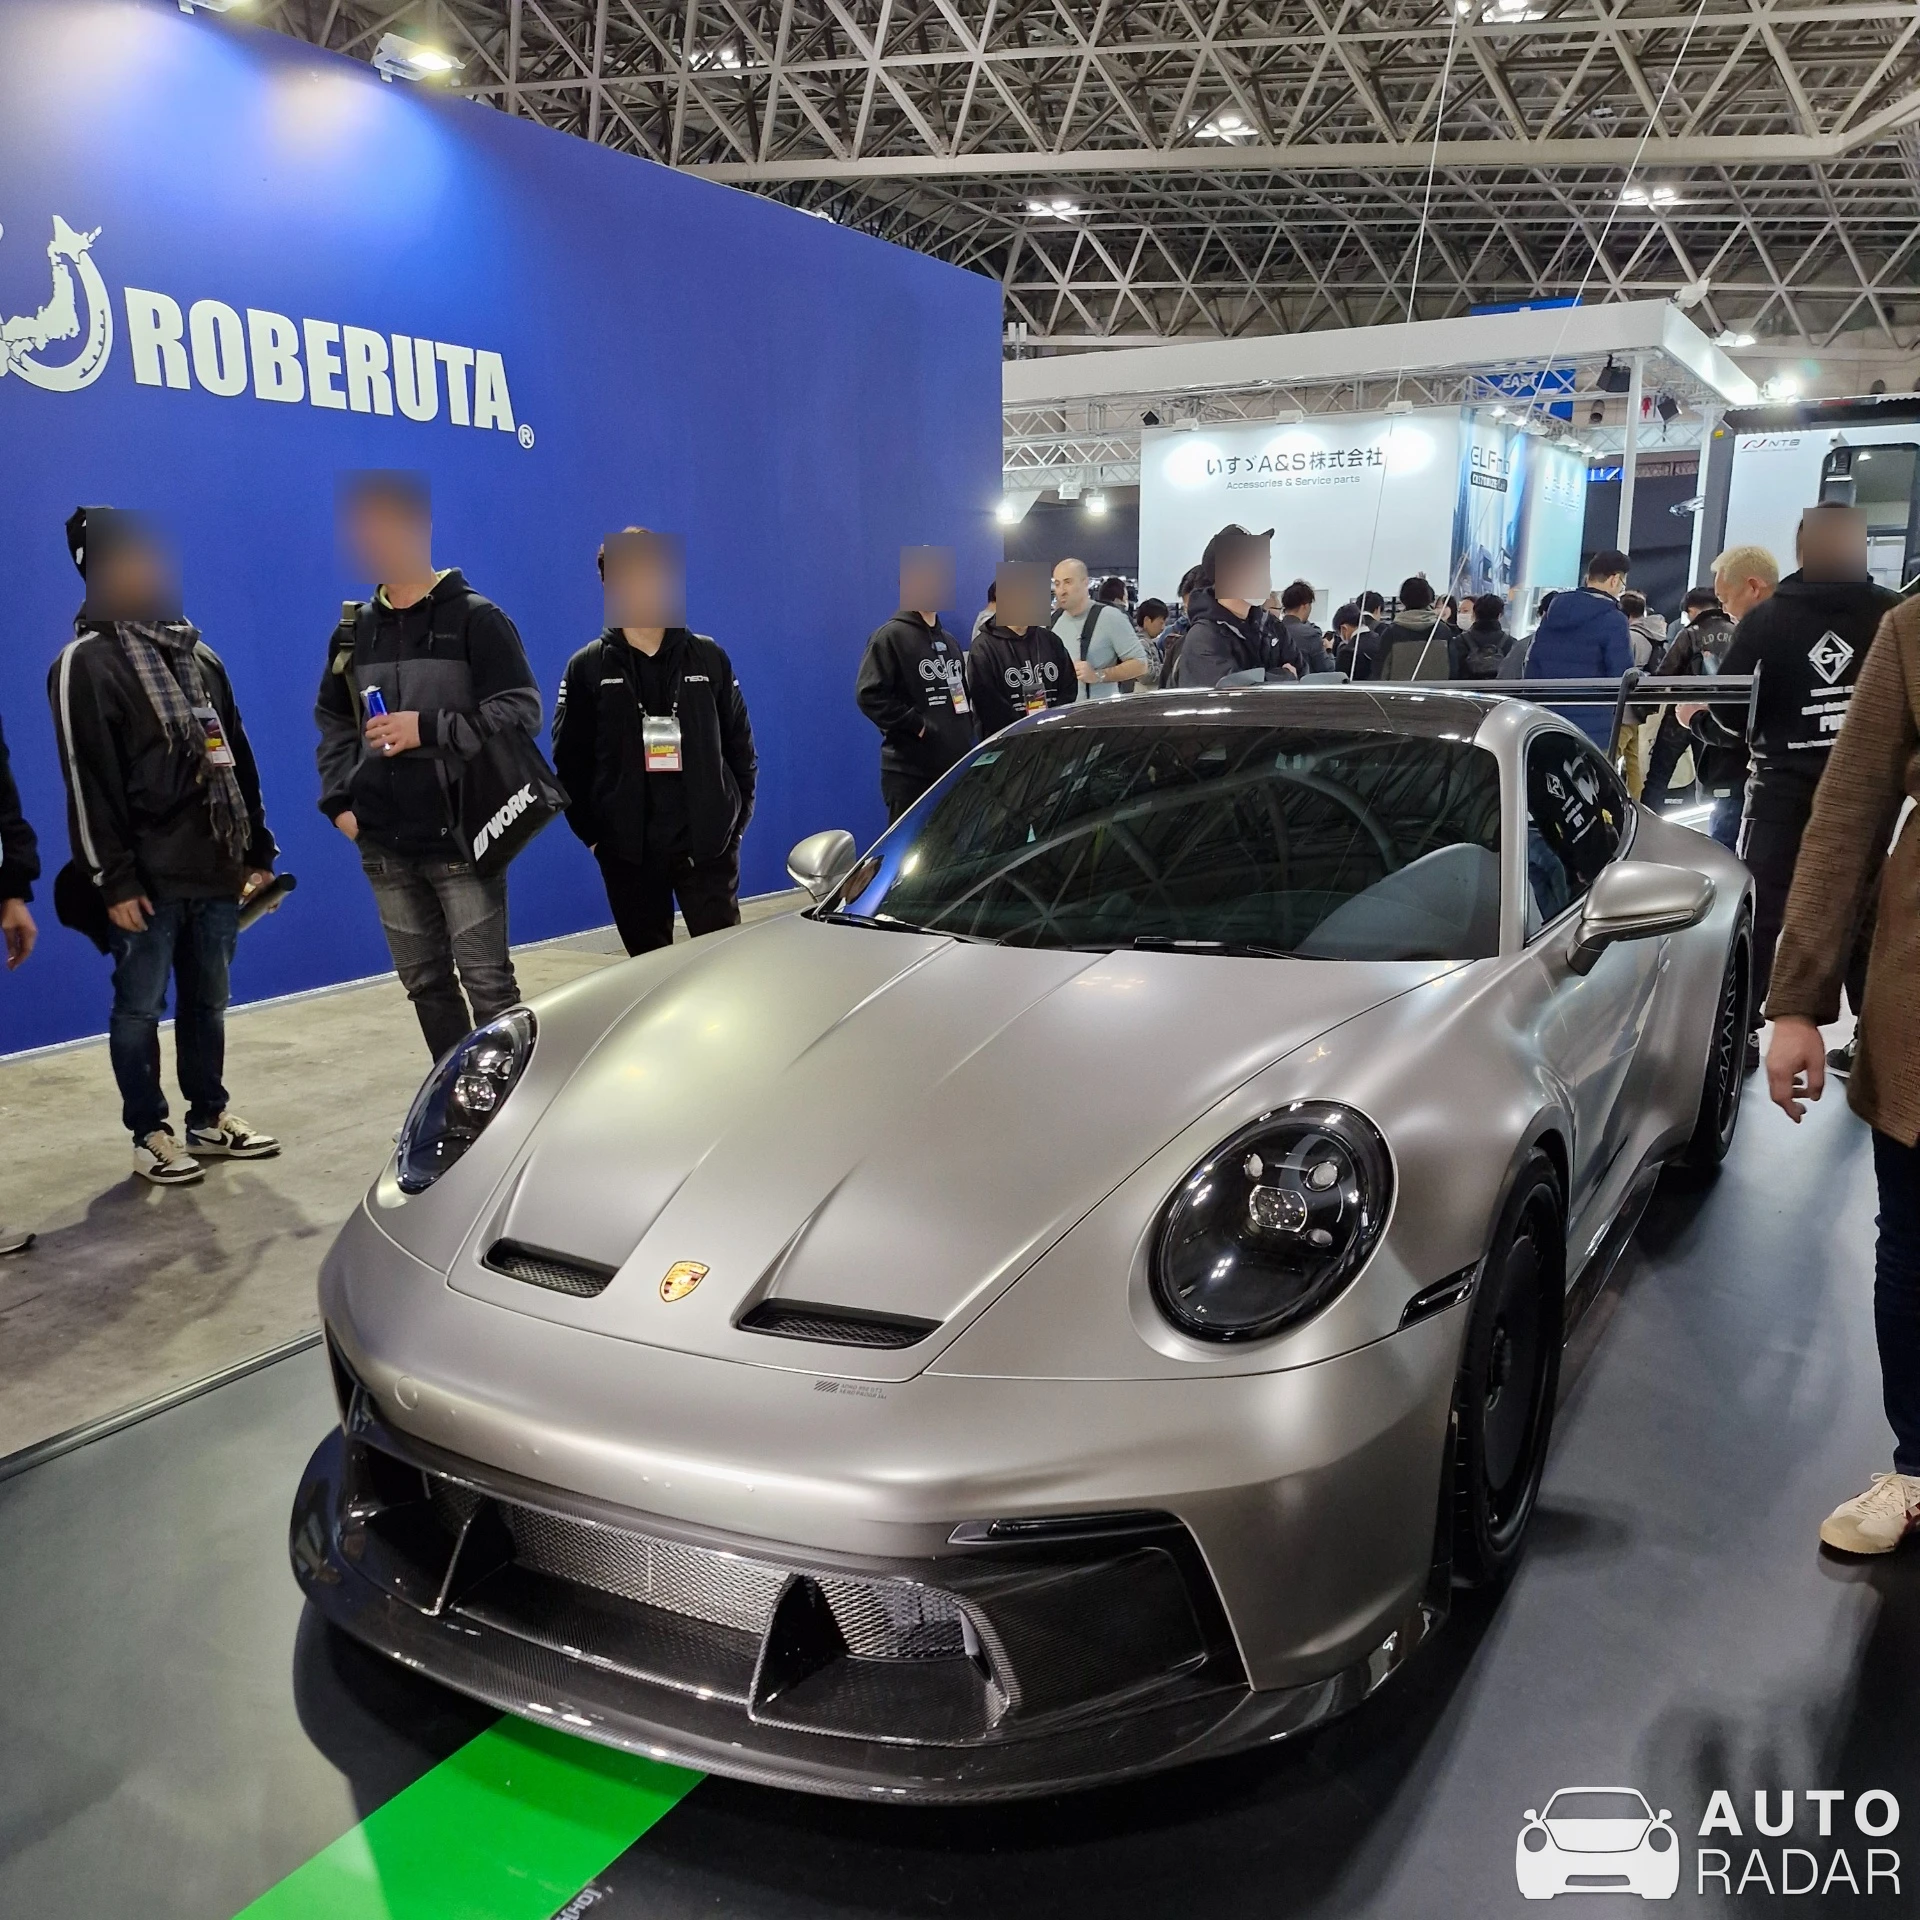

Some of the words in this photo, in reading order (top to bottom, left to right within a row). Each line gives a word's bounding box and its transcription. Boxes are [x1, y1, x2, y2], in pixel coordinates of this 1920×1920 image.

[124, 286, 516, 432] ROBERUTA
[1226, 479, 1283, 490] Accessories
[1285, 478, 1293, 487] &
[1295, 476, 1332, 486] Service
[1333, 475, 1361, 485] parts
[486, 782, 535, 840] WORK
